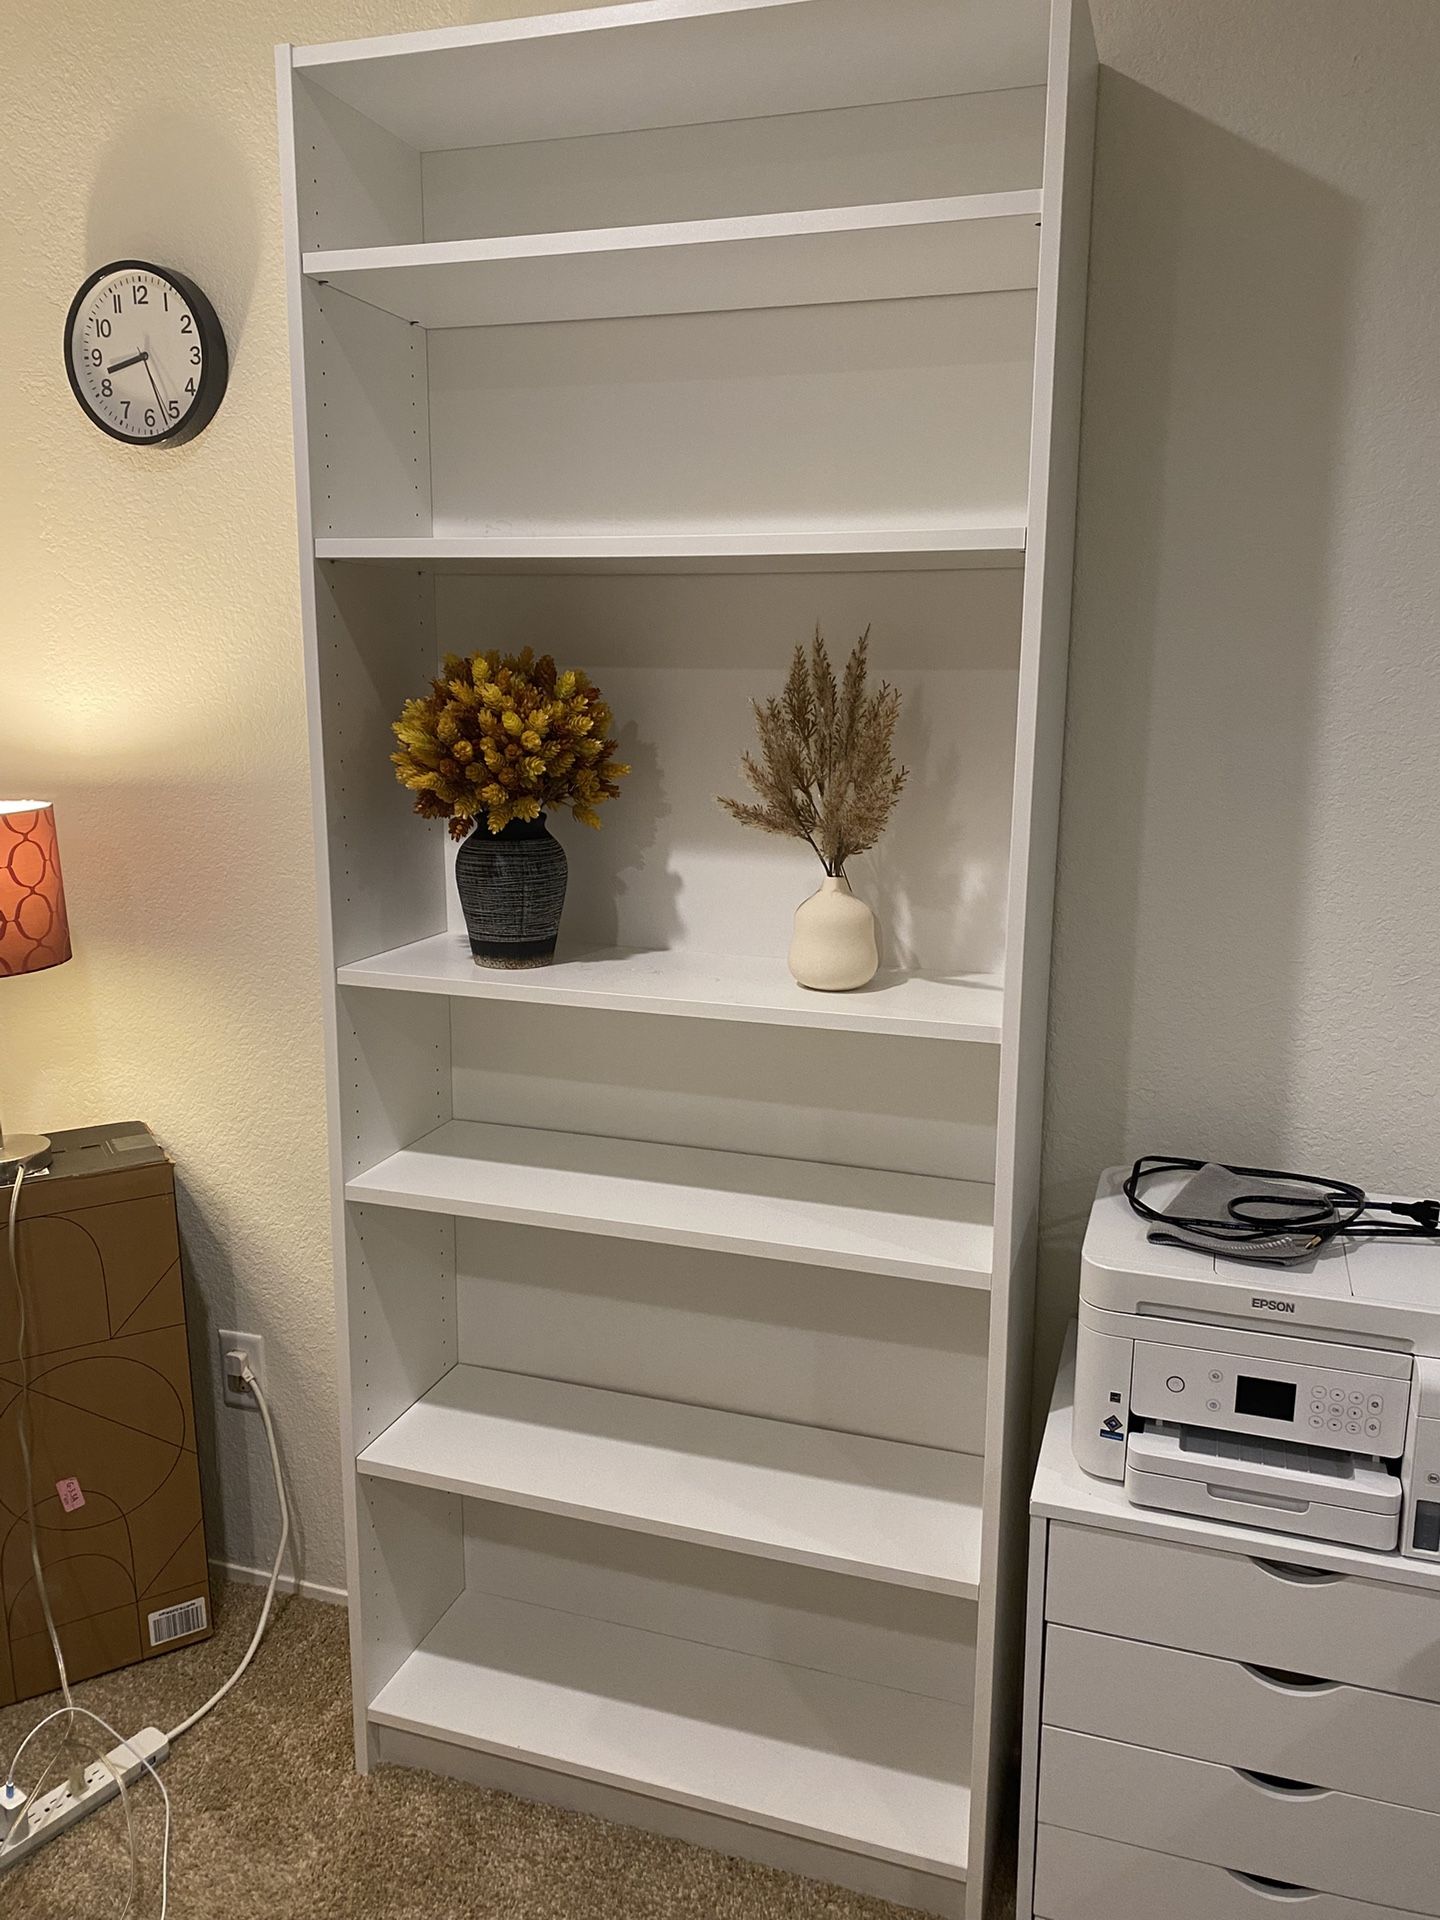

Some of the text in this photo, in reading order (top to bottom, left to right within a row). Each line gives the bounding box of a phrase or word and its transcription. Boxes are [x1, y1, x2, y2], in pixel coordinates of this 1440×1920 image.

[113, 294, 122, 313] 11
[133, 285, 149, 305] 12
[164, 293, 168, 312] 1
[96, 319, 111, 338] 10
[180, 315, 192, 334] 2
[92, 349, 102, 367] 9
[189, 346, 200, 365] 3
[101, 379, 113, 397] 8
[185, 378, 196, 396] 4
[120, 401, 130, 419] 7
[144, 408, 155, 427] 6
[168, 401, 179, 418] 5
[1251, 1297, 1295, 1313] EPSON
